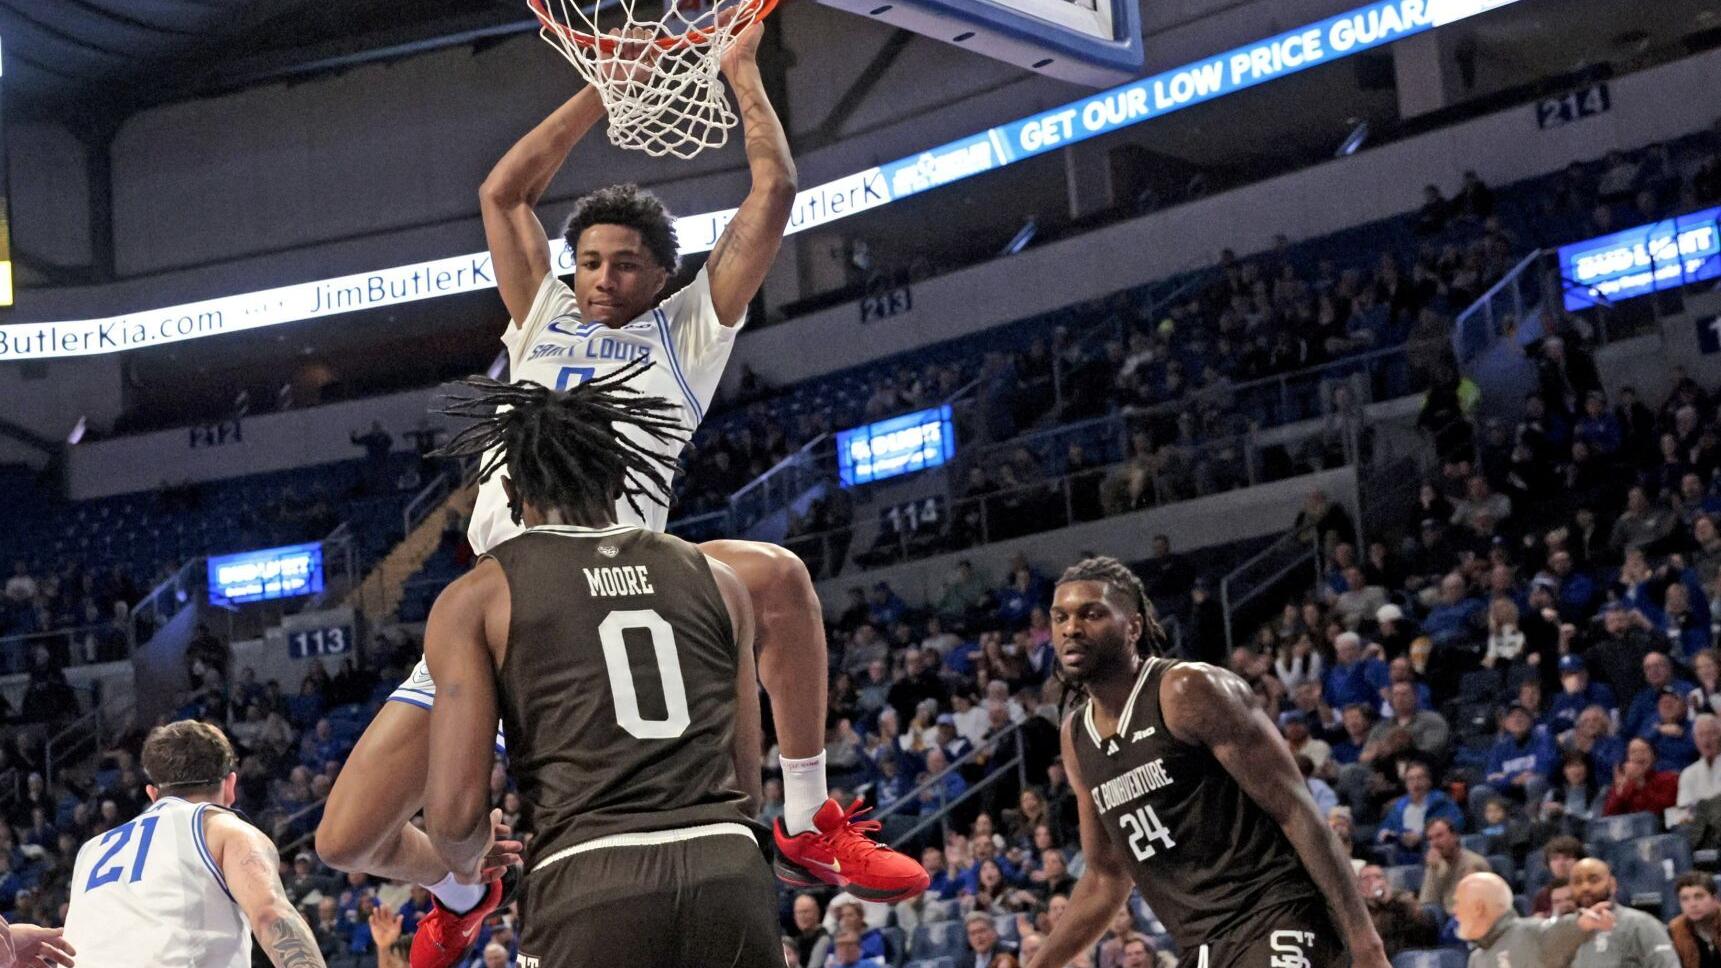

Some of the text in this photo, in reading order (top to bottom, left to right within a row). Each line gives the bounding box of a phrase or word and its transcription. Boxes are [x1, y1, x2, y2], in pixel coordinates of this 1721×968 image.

[1020, 109, 1077, 151] GET
[1083, 87, 1148, 131] OUR
[1154, 61, 1223, 109] LOW
[1230, 28, 1324, 84] PRICE
[1542, 87, 1603, 128] 214
[864, 289, 907, 320] 213
[586, 338, 650, 364] LOUIS
[888, 499, 937, 532] 114
[583, 565, 655, 597] MOORE
[296, 628, 345, 656] 113
[598, 609, 691, 739] 0
[1100, 758, 1174, 811] BONAVENTURE
[1119, 804, 1176, 862] 24
[85, 816, 160, 893] 21
